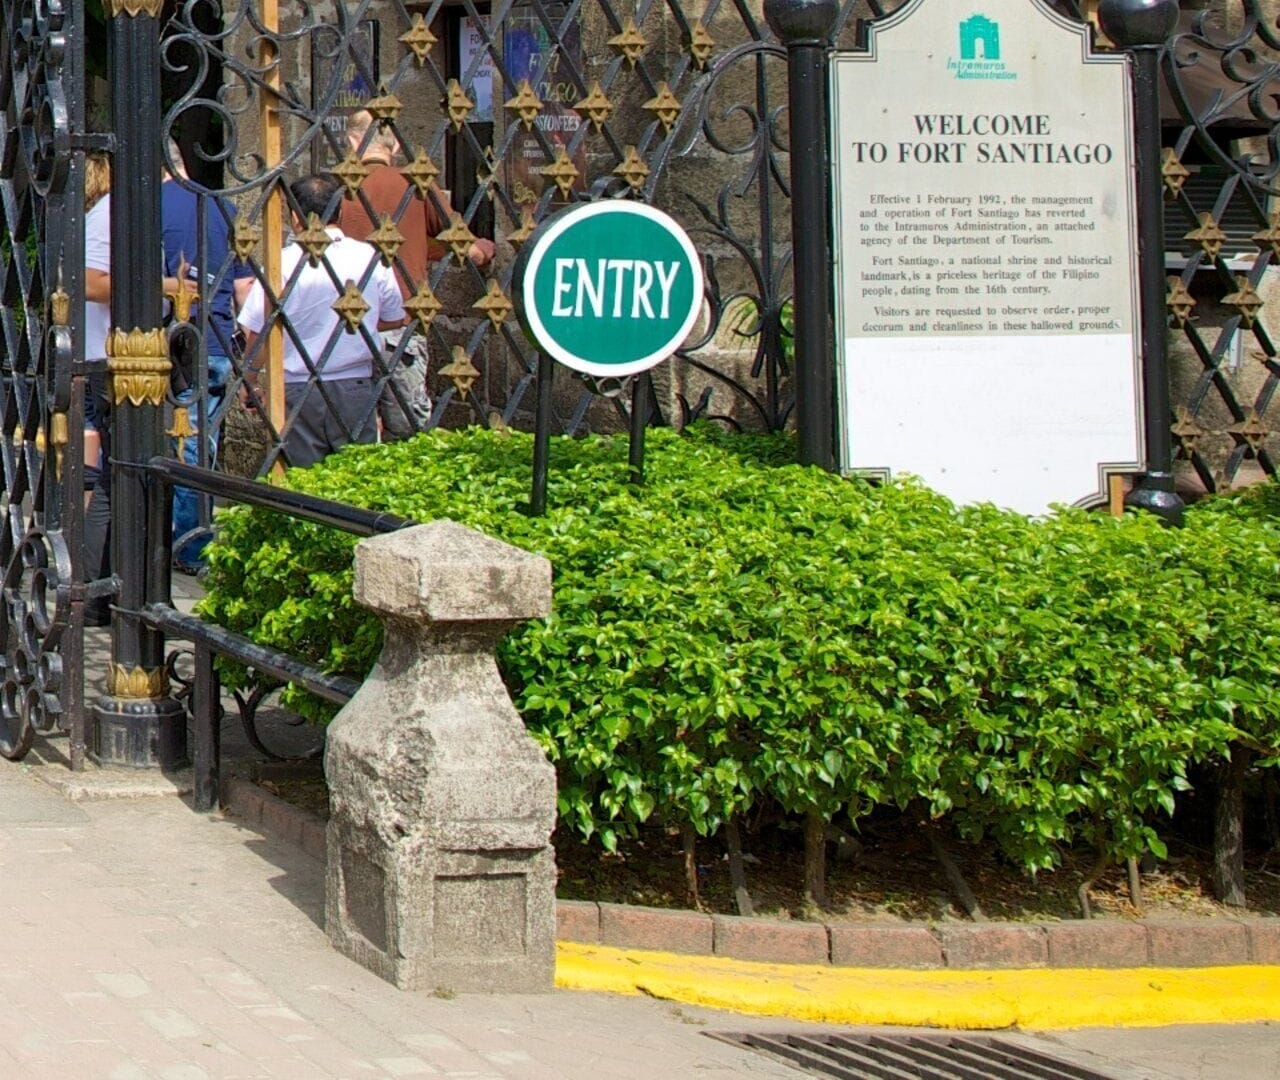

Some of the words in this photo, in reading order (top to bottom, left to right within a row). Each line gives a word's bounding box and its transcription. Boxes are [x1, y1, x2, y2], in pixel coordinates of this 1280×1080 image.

[947, 57, 1005, 70] Intramuros
[954, 70, 1017, 80] Administration
[914, 114, 1050, 136] WELCOME
[852, 142, 887, 163] TO
[898, 142, 967, 164] FORT
[977, 142, 1112, 165] SANTIAGO
[870, 194, 911, 204] Effective
[927, 194, 972, 206] February
[1011, 194, 1026, 204] the
[1032, 196, 1093, 206] management
[859, 208, 878, 218] and
[884, 208, 930, 220] operation
[935, 208, 945, 218] of
[951, 208, 972, 218] Fort
[978, 208, 1019, 220] Santiago
[1025, 208, 1041, 218] has
[1046, 208, 1086, 218] reverted
[860, 222, 869, 231] to
[874, 222, 889, 232] the
[895, 222, 949, 232] Intramuros
[954, 222, 1032, 232] Administration,
[1054, 222, 1095, 232] attached
[860, 237, 892, 247] agency
[897, 235, 908, 245] of
[912, 235, 927, 245] the
[933, 235, 990, 247] Department
[995, 235, 1006, 245] of
[1011, 234, 1053, 245] Tourism.
[872, 256, 893, 266] Fort
[961, 255, 1001, 265] national
[1008, 255, 1038, 265] shrine
[1044, 255, 1062, 265] and
[1068, 255, 1112, 265] historical
[937, 270, 977, 282] priceless
[982, 270, 1021, 281] heritage
[1027, 270, 1036, 279] of
[1042, 270, 1057, 279] the
[1063, 269, 1100, 281] Filipino
[552, 258, 680, 319] ENTRY
[901, 286, 931, 296] dating
[936, 285, 959, 295] from
[965, 285, 980, 295] the
[986, 285, 1007, 294] 16th
[1012, 285, 1051, 295] century.
[874, 306, 910, 316] Visitors
[936, 306, 981, 318] requested
[987, 307, 996, 315] to
[1001, 306, 1038, 315] observe
[1078, 306, 1111, 316] proper
[862, 322, 903, 332] decorum
[909, 322, 927, 331] and
[933, 321, 983, 331] cleanliness
[989, 321, 998, 330] in
[1003, 321, 1029, 330] these
[1031, 320, 1073, 330] hallowed
